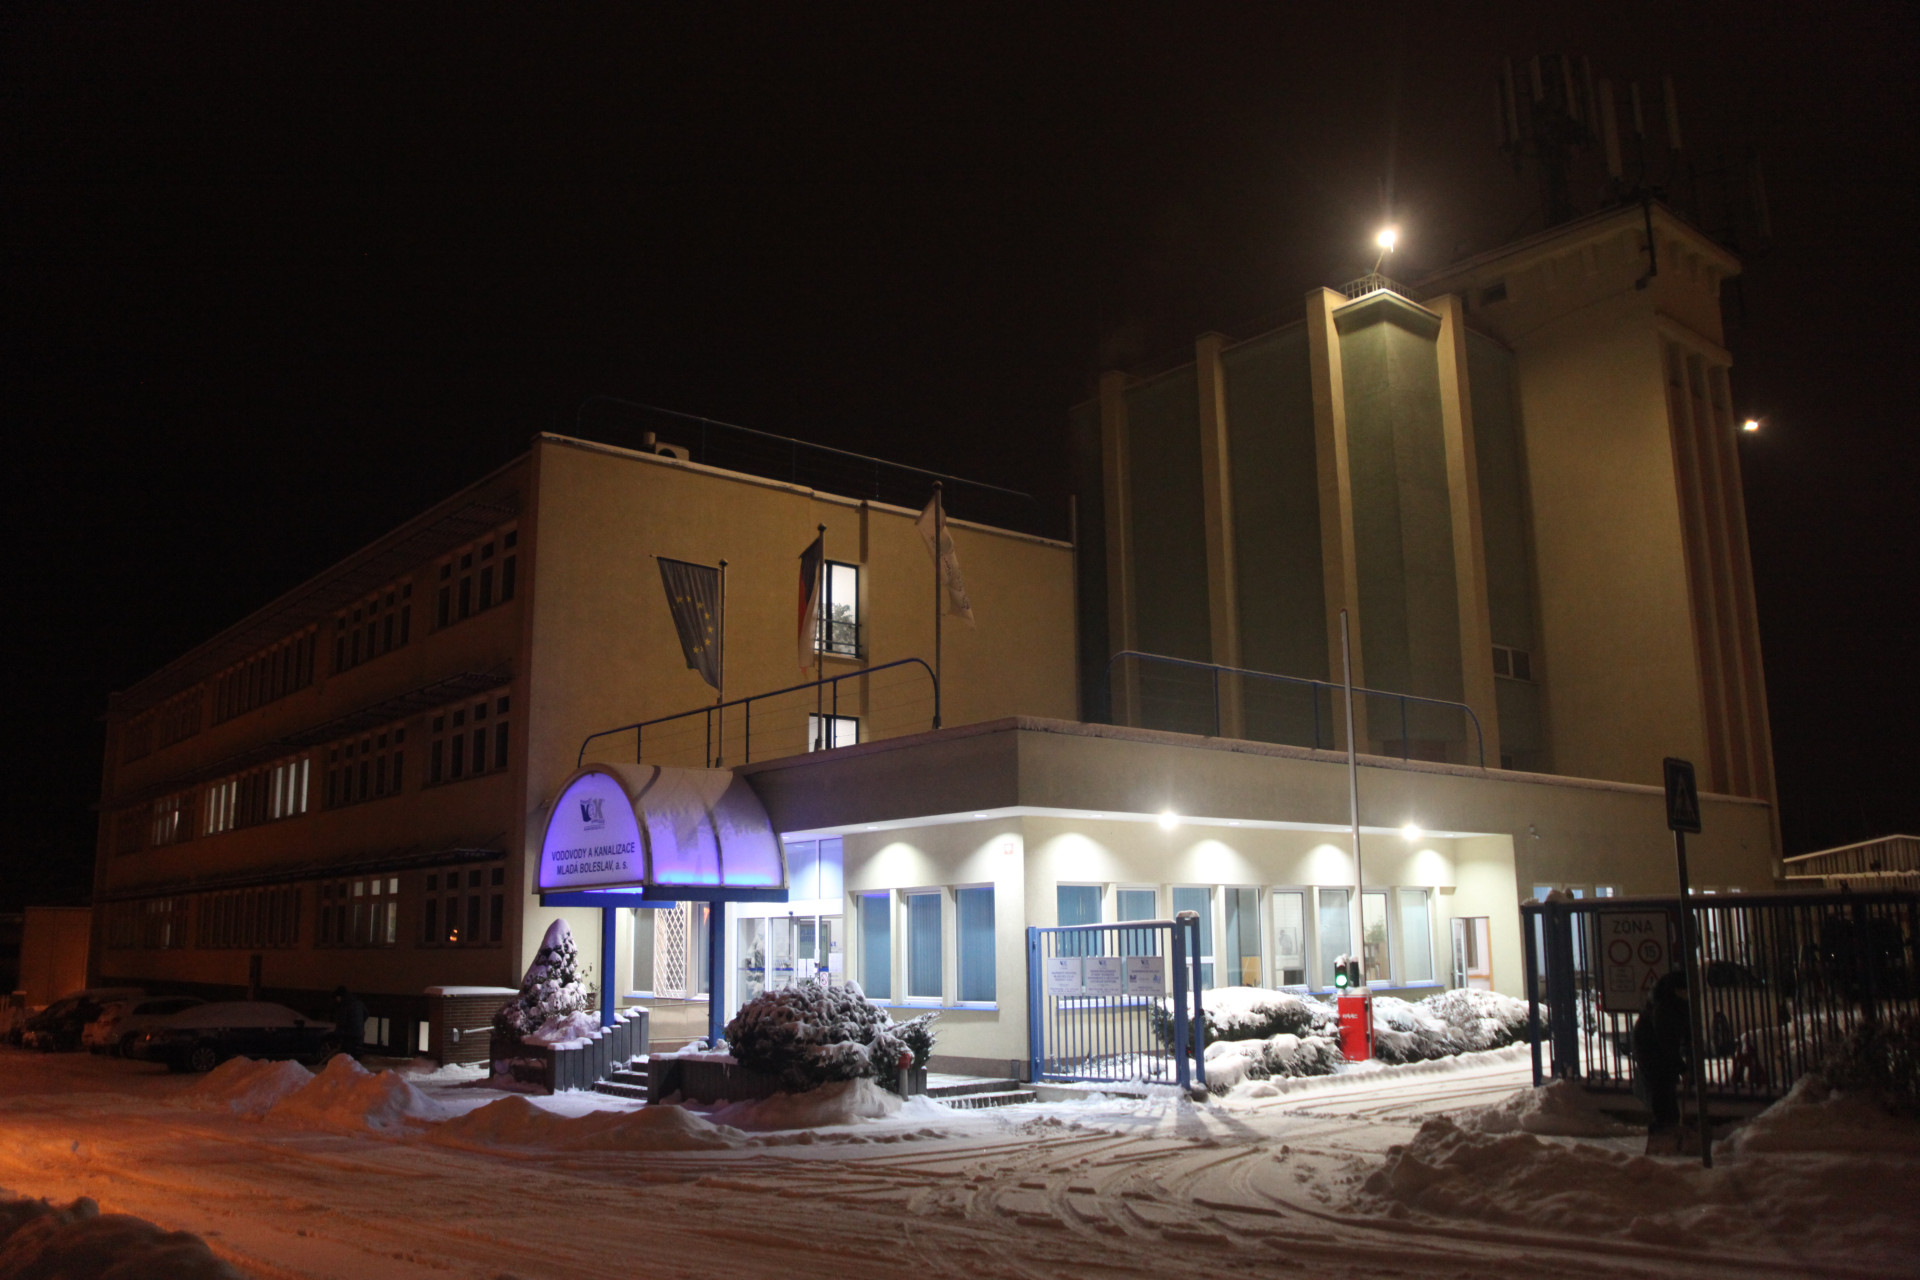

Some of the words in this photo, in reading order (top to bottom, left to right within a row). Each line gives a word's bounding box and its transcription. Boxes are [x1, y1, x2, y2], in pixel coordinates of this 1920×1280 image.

[551, 847, 587, 861] VODOVODY
[588, 847, 593, 857] A
[594, 842, 635, 857] KANALIZACE
[556, 861, 578, 875] MLADÁ
[1644, 945, 1656, 958] 15
